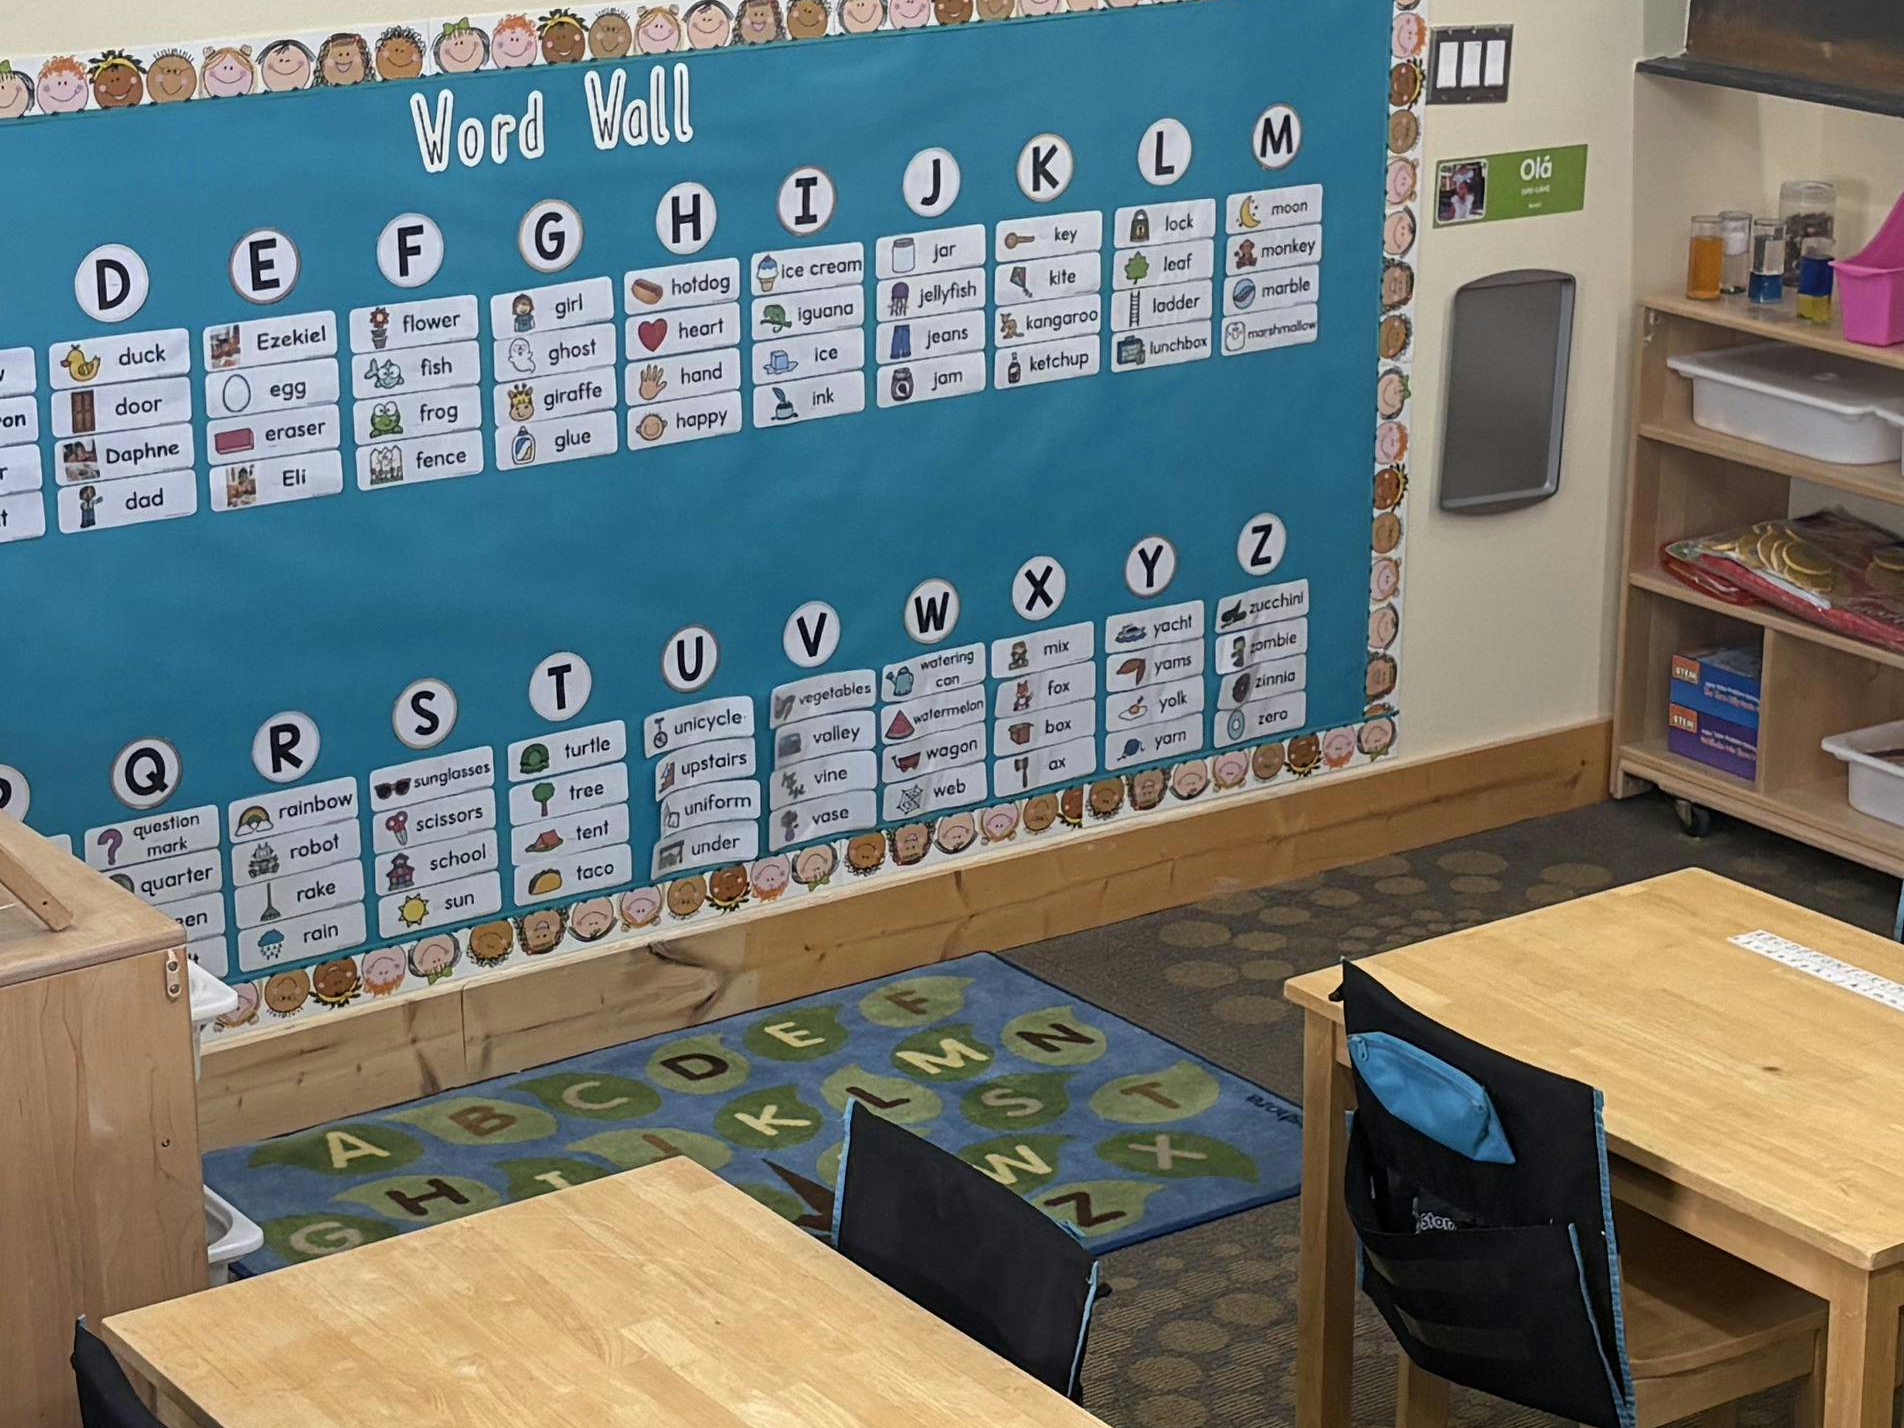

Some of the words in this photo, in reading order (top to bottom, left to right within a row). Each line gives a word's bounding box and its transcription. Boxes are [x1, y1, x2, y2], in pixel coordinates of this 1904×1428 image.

[410, 89, 544, 172] Word
[584, 63, 693, 150] Wall
[1261, 115, 1292, 157] M
[672, 194, 701, 243] H
[1272, 202, 1307, 215] moon
[1262, 238, 1315, 257] monkey
[96, 259, 130, 310] D
[672, 274, 730, 295] hotdog
[679, 318, 723, 339] heart
[119, 344, 165, 365] duck
[681, 362, 722, 384] hand
[116, 397, 162, 415] door
[677, 411, 727, 430] happy
[106, 443, 179, 465] Daphne
[126, 488, 163, 510] dad
[1251, 524, 1272, 566] Z
[1138, 545, 1163, 588] Y
[548, 664, 571, 710] T
[1159, 690, 1187, 713] yolk
[1259, 710, 1287, 725] zero
[270, 724, 303, 773] R
[565, 737, 610, 758] turtle
[570, 784, 603, 800] tree
[280, 794, 352, 818] rainbow
[577, 820, 608, 840] tent
[290, 834, 338, 859] robot
[577, 864, 614, 880] taco
[297, 881, 335, 902] rake
[304, 924, 338, 943] rain
[776, 1019, 825, 1050] E
[1018, 1023, 1093, 1055] N
[900, 1036, 989, 1076] M
